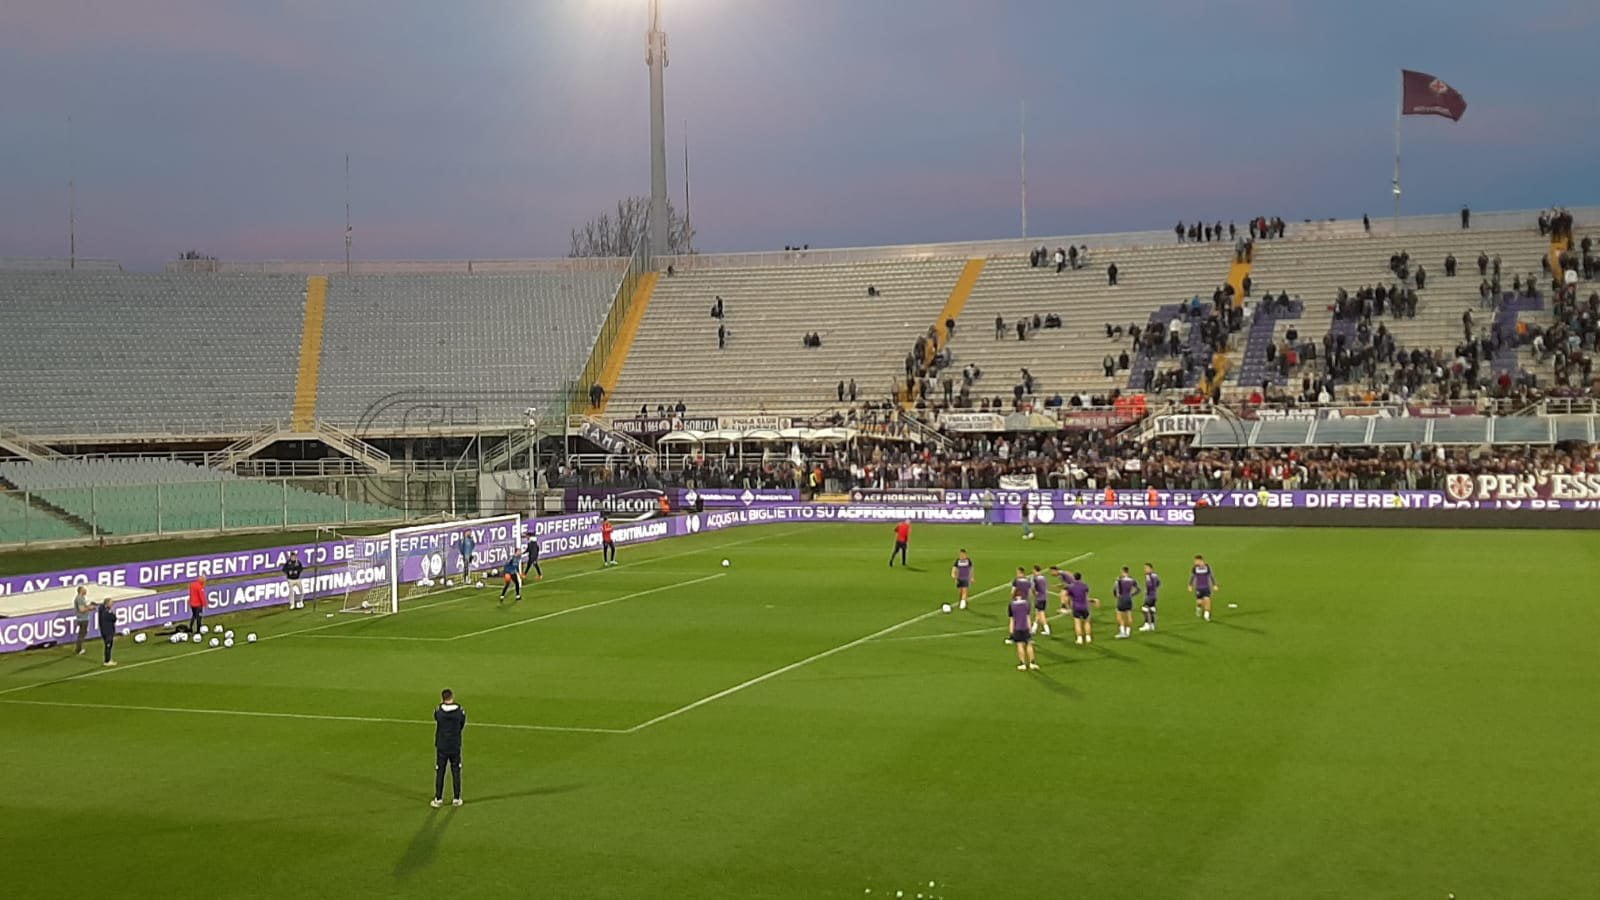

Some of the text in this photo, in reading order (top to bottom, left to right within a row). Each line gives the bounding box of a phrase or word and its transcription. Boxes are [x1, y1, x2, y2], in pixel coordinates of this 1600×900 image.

[1156, 417, 1216, 433] TRENT
[577, 494, 658, 512] Mediacom
[882, 494, 938, 502] FIORENTINA
[945, 492, 984, 505] PLA
[997, 492, 1021, 505] TO
[1028, 492, 1052, 505] BE
[1231, 493, 1257, 507] TO
[1267, 493, 1294, 507] BE
[1306, 493, 1424, 508] DIFFERENT
[749, 506, 813, 520] BIGLIETTO
[816, 506, 834, 518] SU
[837, 507, 985, 519] ACFFIORENTINA.COM
[1071, 509, 1147, 522] ACQUISTA
[1150, 509, 1164, 521] IL
[568, 535, 582, 550] SU
[98, 569, 126, 586] BE
[139, 556, 249, 584] DIFFERENT
[333, 544, 355, 560] BE
[489, 526, 507, 541] TO
[115, 596, 190, 627] BIGLIETT
[208, 590, 231, 609] SU
